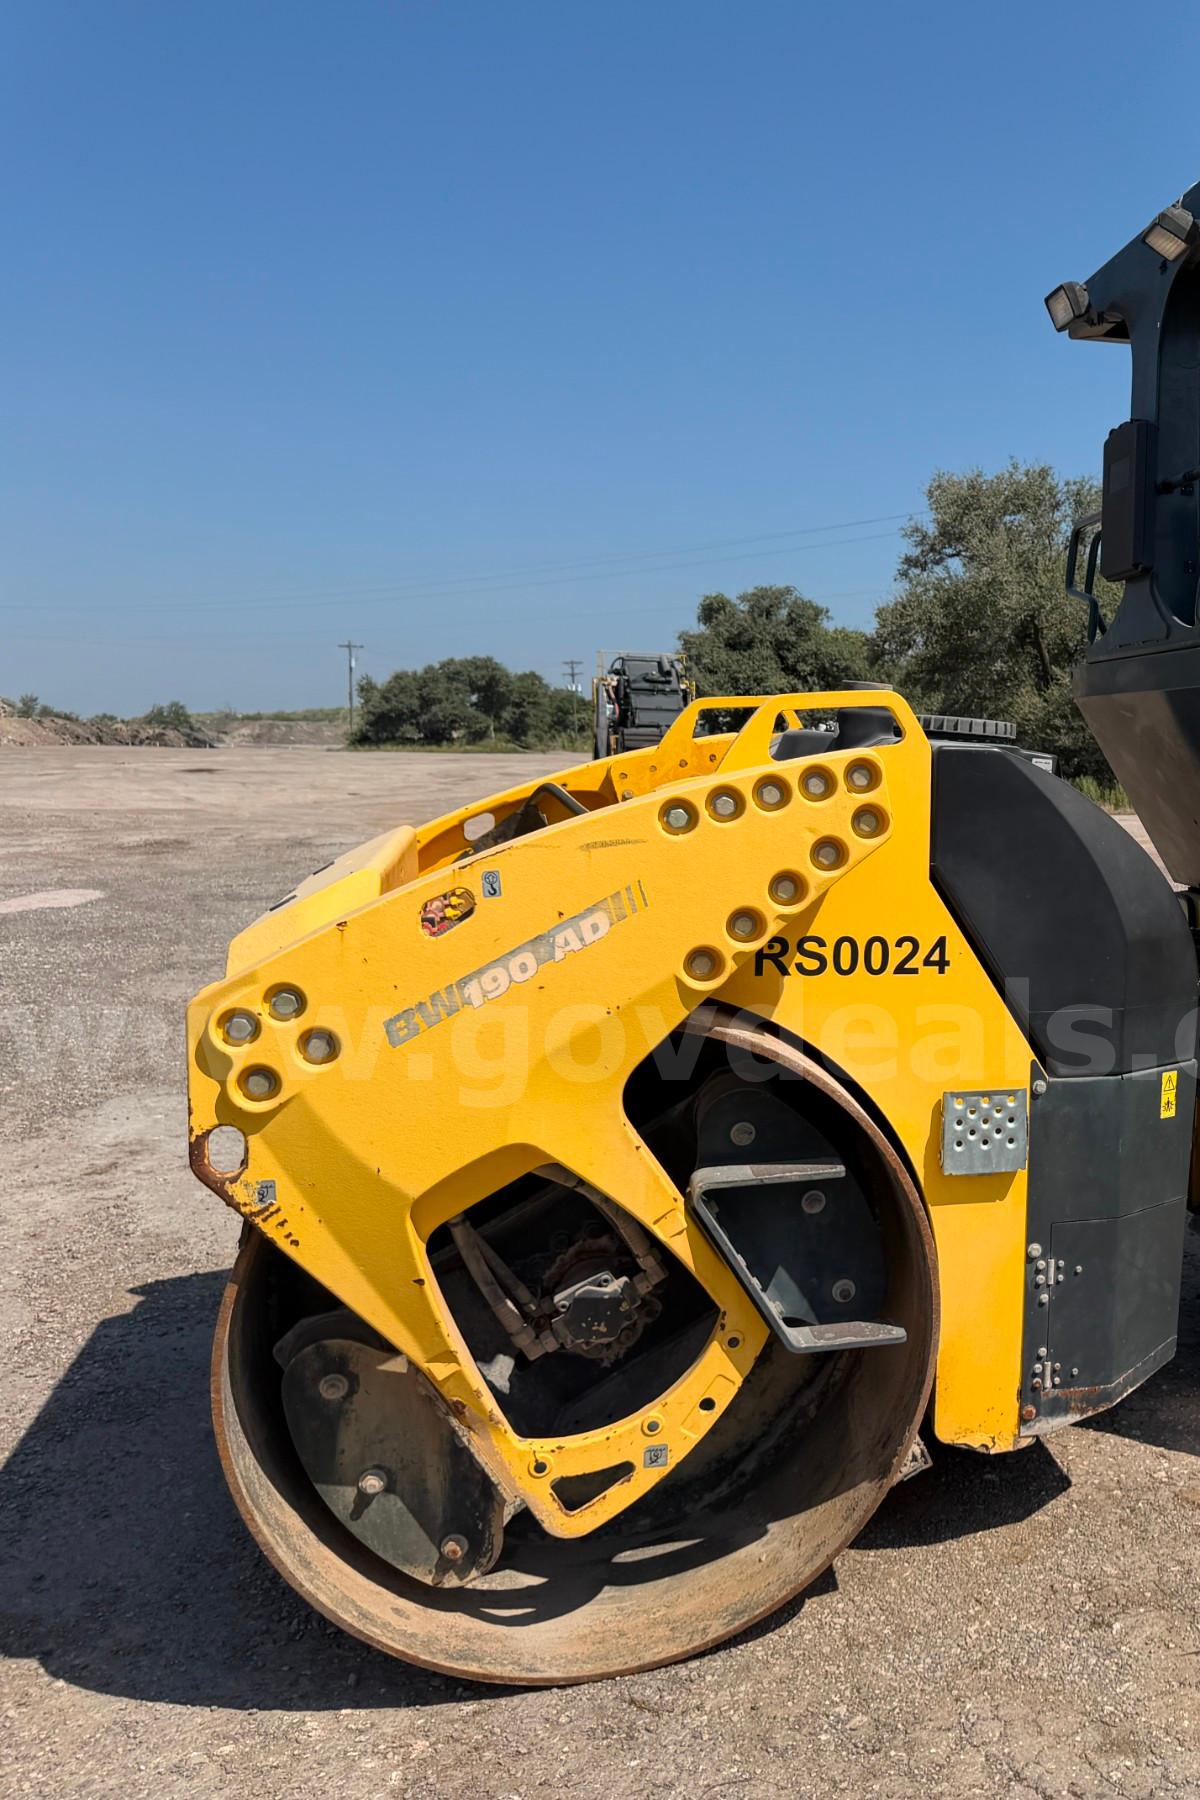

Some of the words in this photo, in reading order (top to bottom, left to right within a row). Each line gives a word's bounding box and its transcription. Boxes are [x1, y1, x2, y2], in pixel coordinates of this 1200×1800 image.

[463, 951, 538, 1009] 190
[554, 911, 611, 963] AD
[754, 935, 950, 977] RS0024
